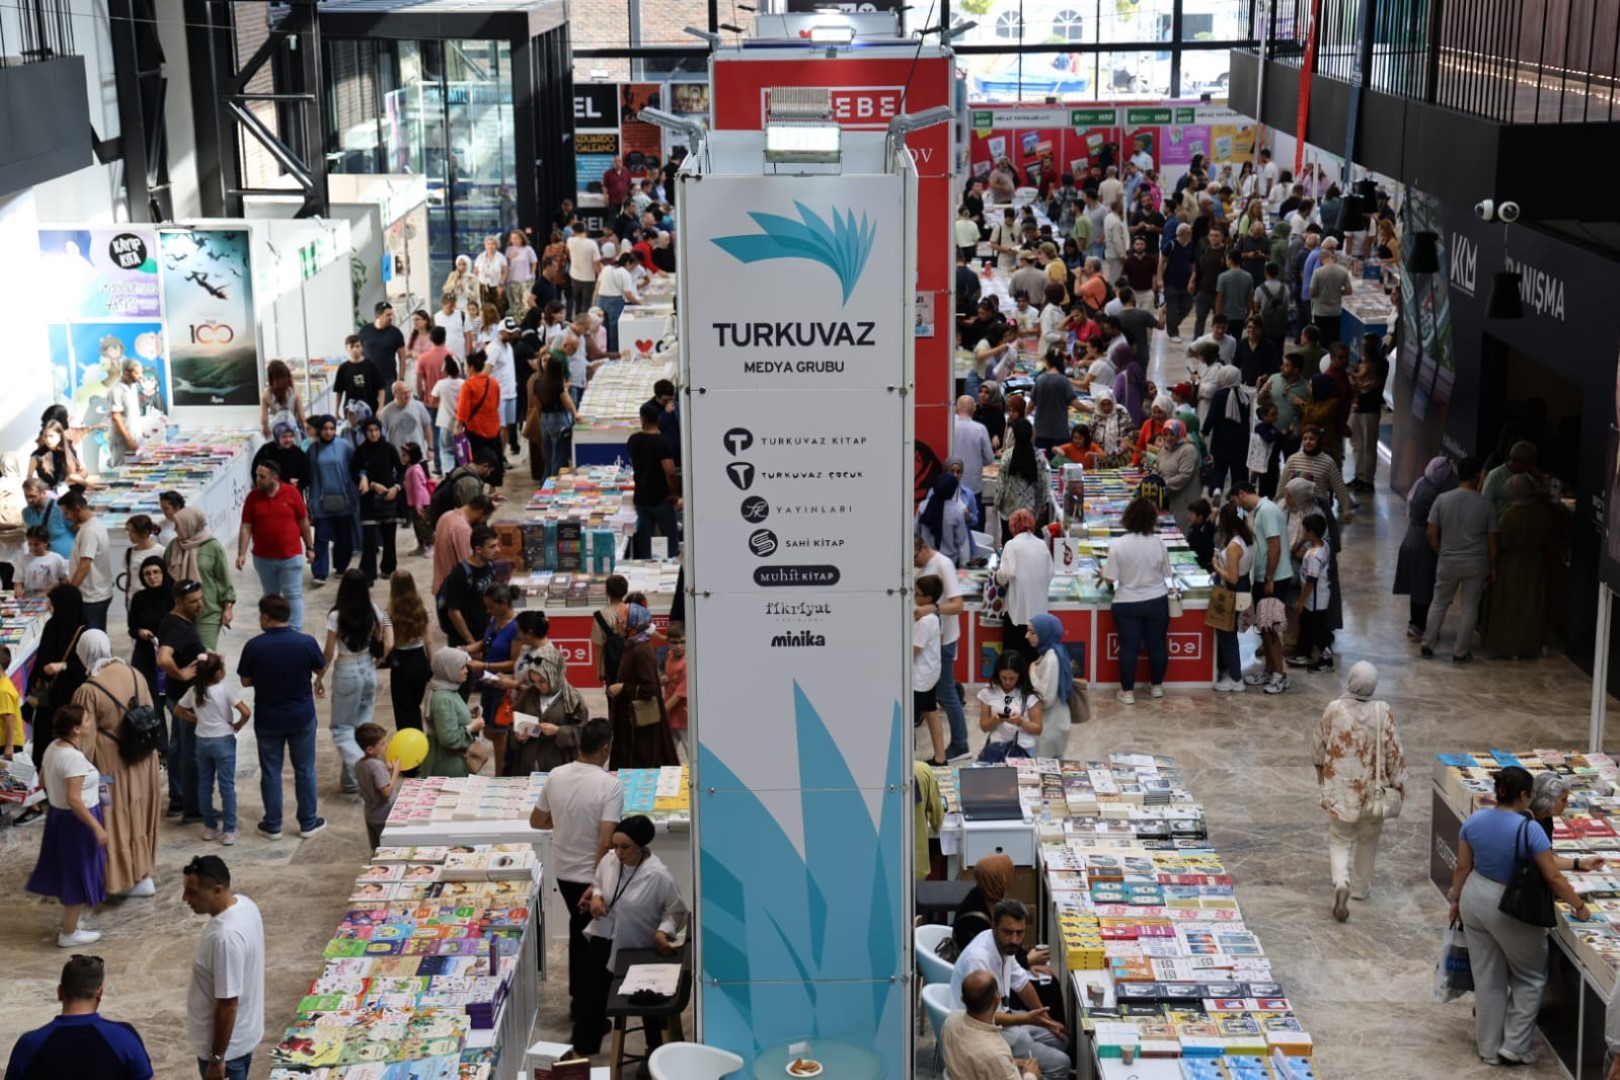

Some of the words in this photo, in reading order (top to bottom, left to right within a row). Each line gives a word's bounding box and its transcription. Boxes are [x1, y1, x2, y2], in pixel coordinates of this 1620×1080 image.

[573, 96, 602, 118] EL
[835, 96, 896, 118] EBE
[712, 321, 876, 347] TURKUVAZ
[744, 361, 794, 373] MEDYA
[796, 360, 845, 373] GRUBU
[761, 437, 826, 445] TURKUVAZ
[832, 436, 867, 444] KİTAP
[776, 505, 853, 514] YAYINLARI
[785, 537, 810, 547] SAHİ
[813, 537, 845, 547] KİTAP
[801, 570, 834, 580] KİTAP
[765, 601, 832, 617] fikriyat
[770, 630, 826, 648] minika
